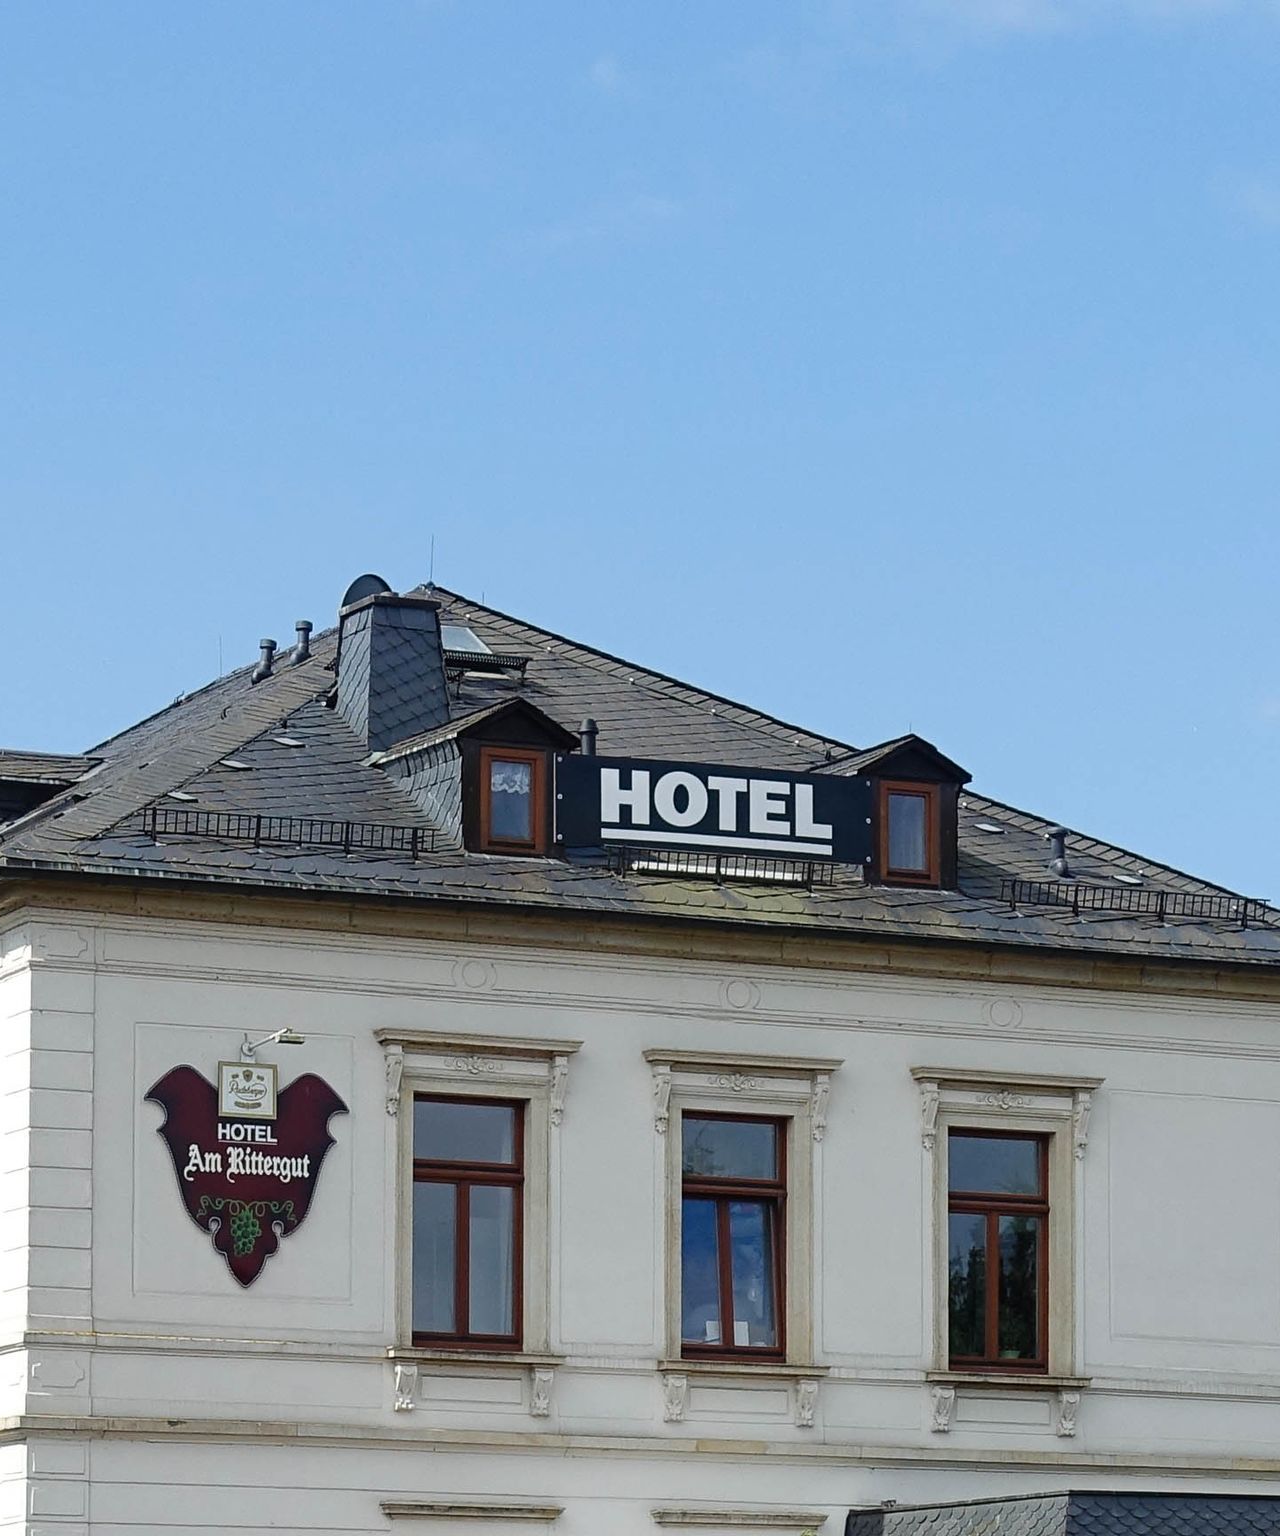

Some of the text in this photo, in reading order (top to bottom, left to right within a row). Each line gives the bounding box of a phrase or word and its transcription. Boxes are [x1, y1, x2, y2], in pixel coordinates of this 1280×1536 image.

[600, 768, 833, 839] HOTEL
[217, 1122, 278, 1142] HOTEL
[183, 1144, 311, 1184] Am Rittergut
